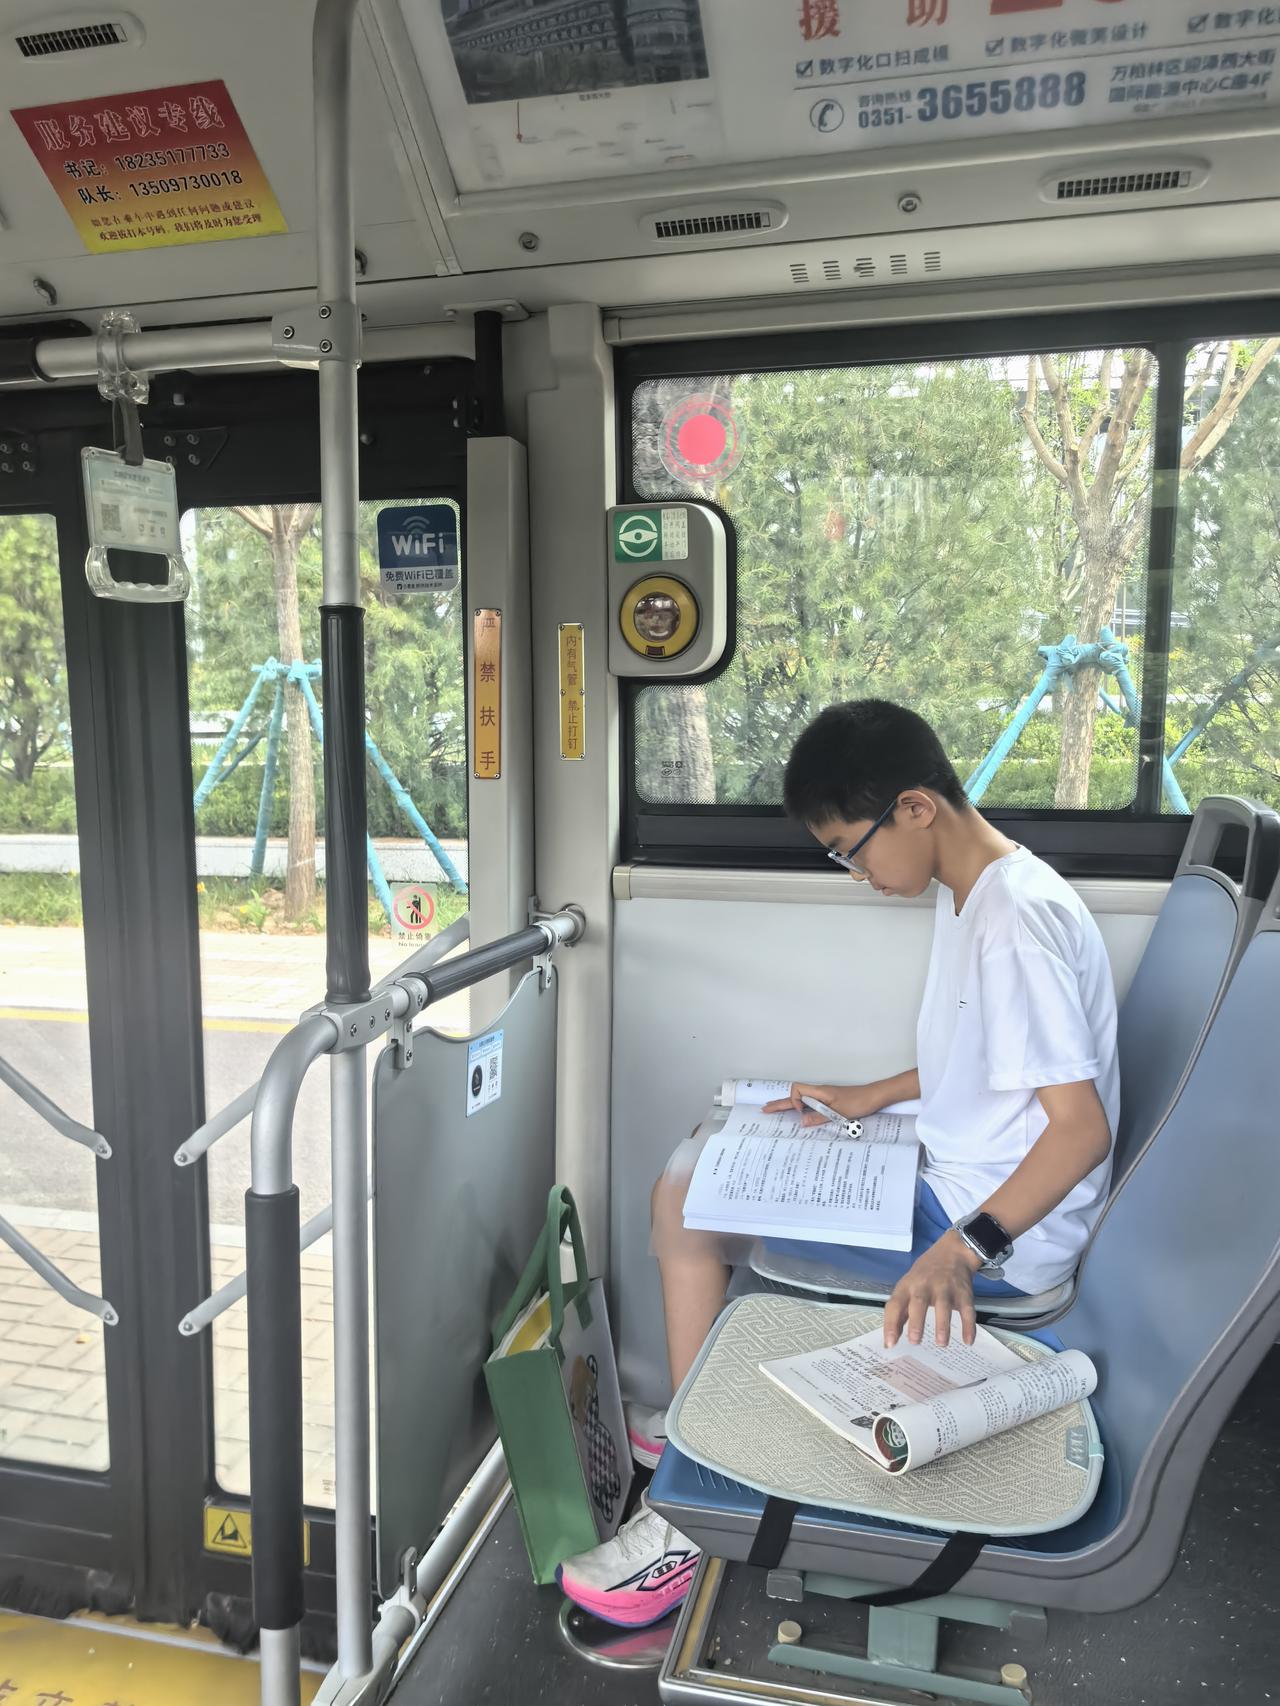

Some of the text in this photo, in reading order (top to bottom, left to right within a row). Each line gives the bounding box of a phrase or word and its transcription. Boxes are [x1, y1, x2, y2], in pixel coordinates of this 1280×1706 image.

[1213, 6, 1280, 30] 数字化
[34, 95, 226, 151] 服务建议专线
[114, 142, 231, 172] 18235177733
[129, 169, 244, 198] 13509730018
[391, 532, 444, 556] WiFi
[385, 569, 454, 582] 免费WiFi已覆盖
